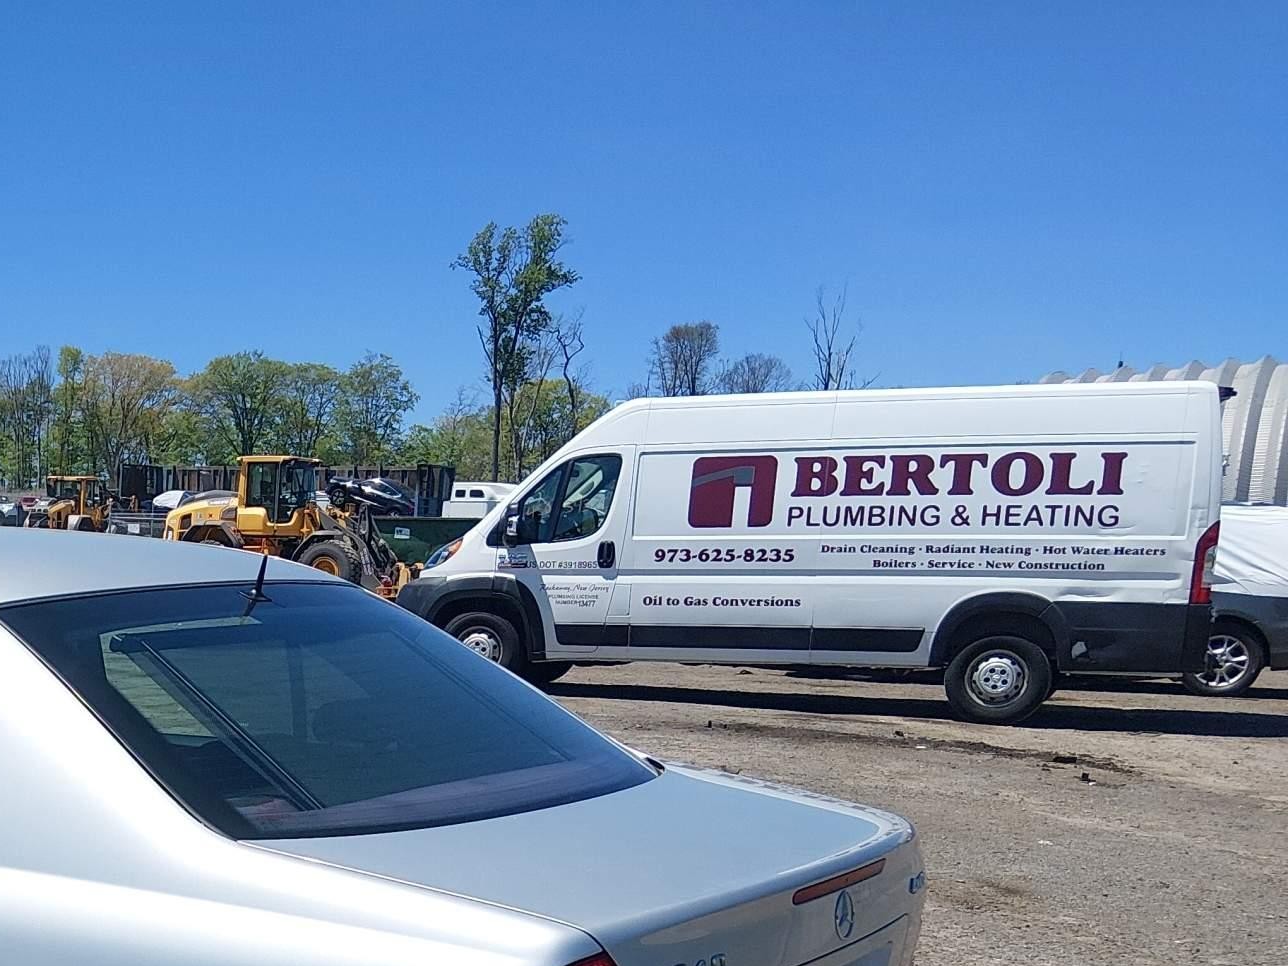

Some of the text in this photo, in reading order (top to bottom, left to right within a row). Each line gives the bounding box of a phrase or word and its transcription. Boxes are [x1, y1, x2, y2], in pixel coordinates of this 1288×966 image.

[790, 452, 1128, 497] BERTOLI
[787, 504, 1120, 527] PLUMBING & HEATING
[654, 548, 795, 563] 973-625-8235
[821, 544, 1167, 557] Drain Cleaning Radiant Heating Hot Water Heaters
[526, 560, 598, 569] US DOT #3918965
[873, 559, 1105, 571] Boilers Service New Construction
[643, 595, 802, 608] Oil to Gas Conversions
